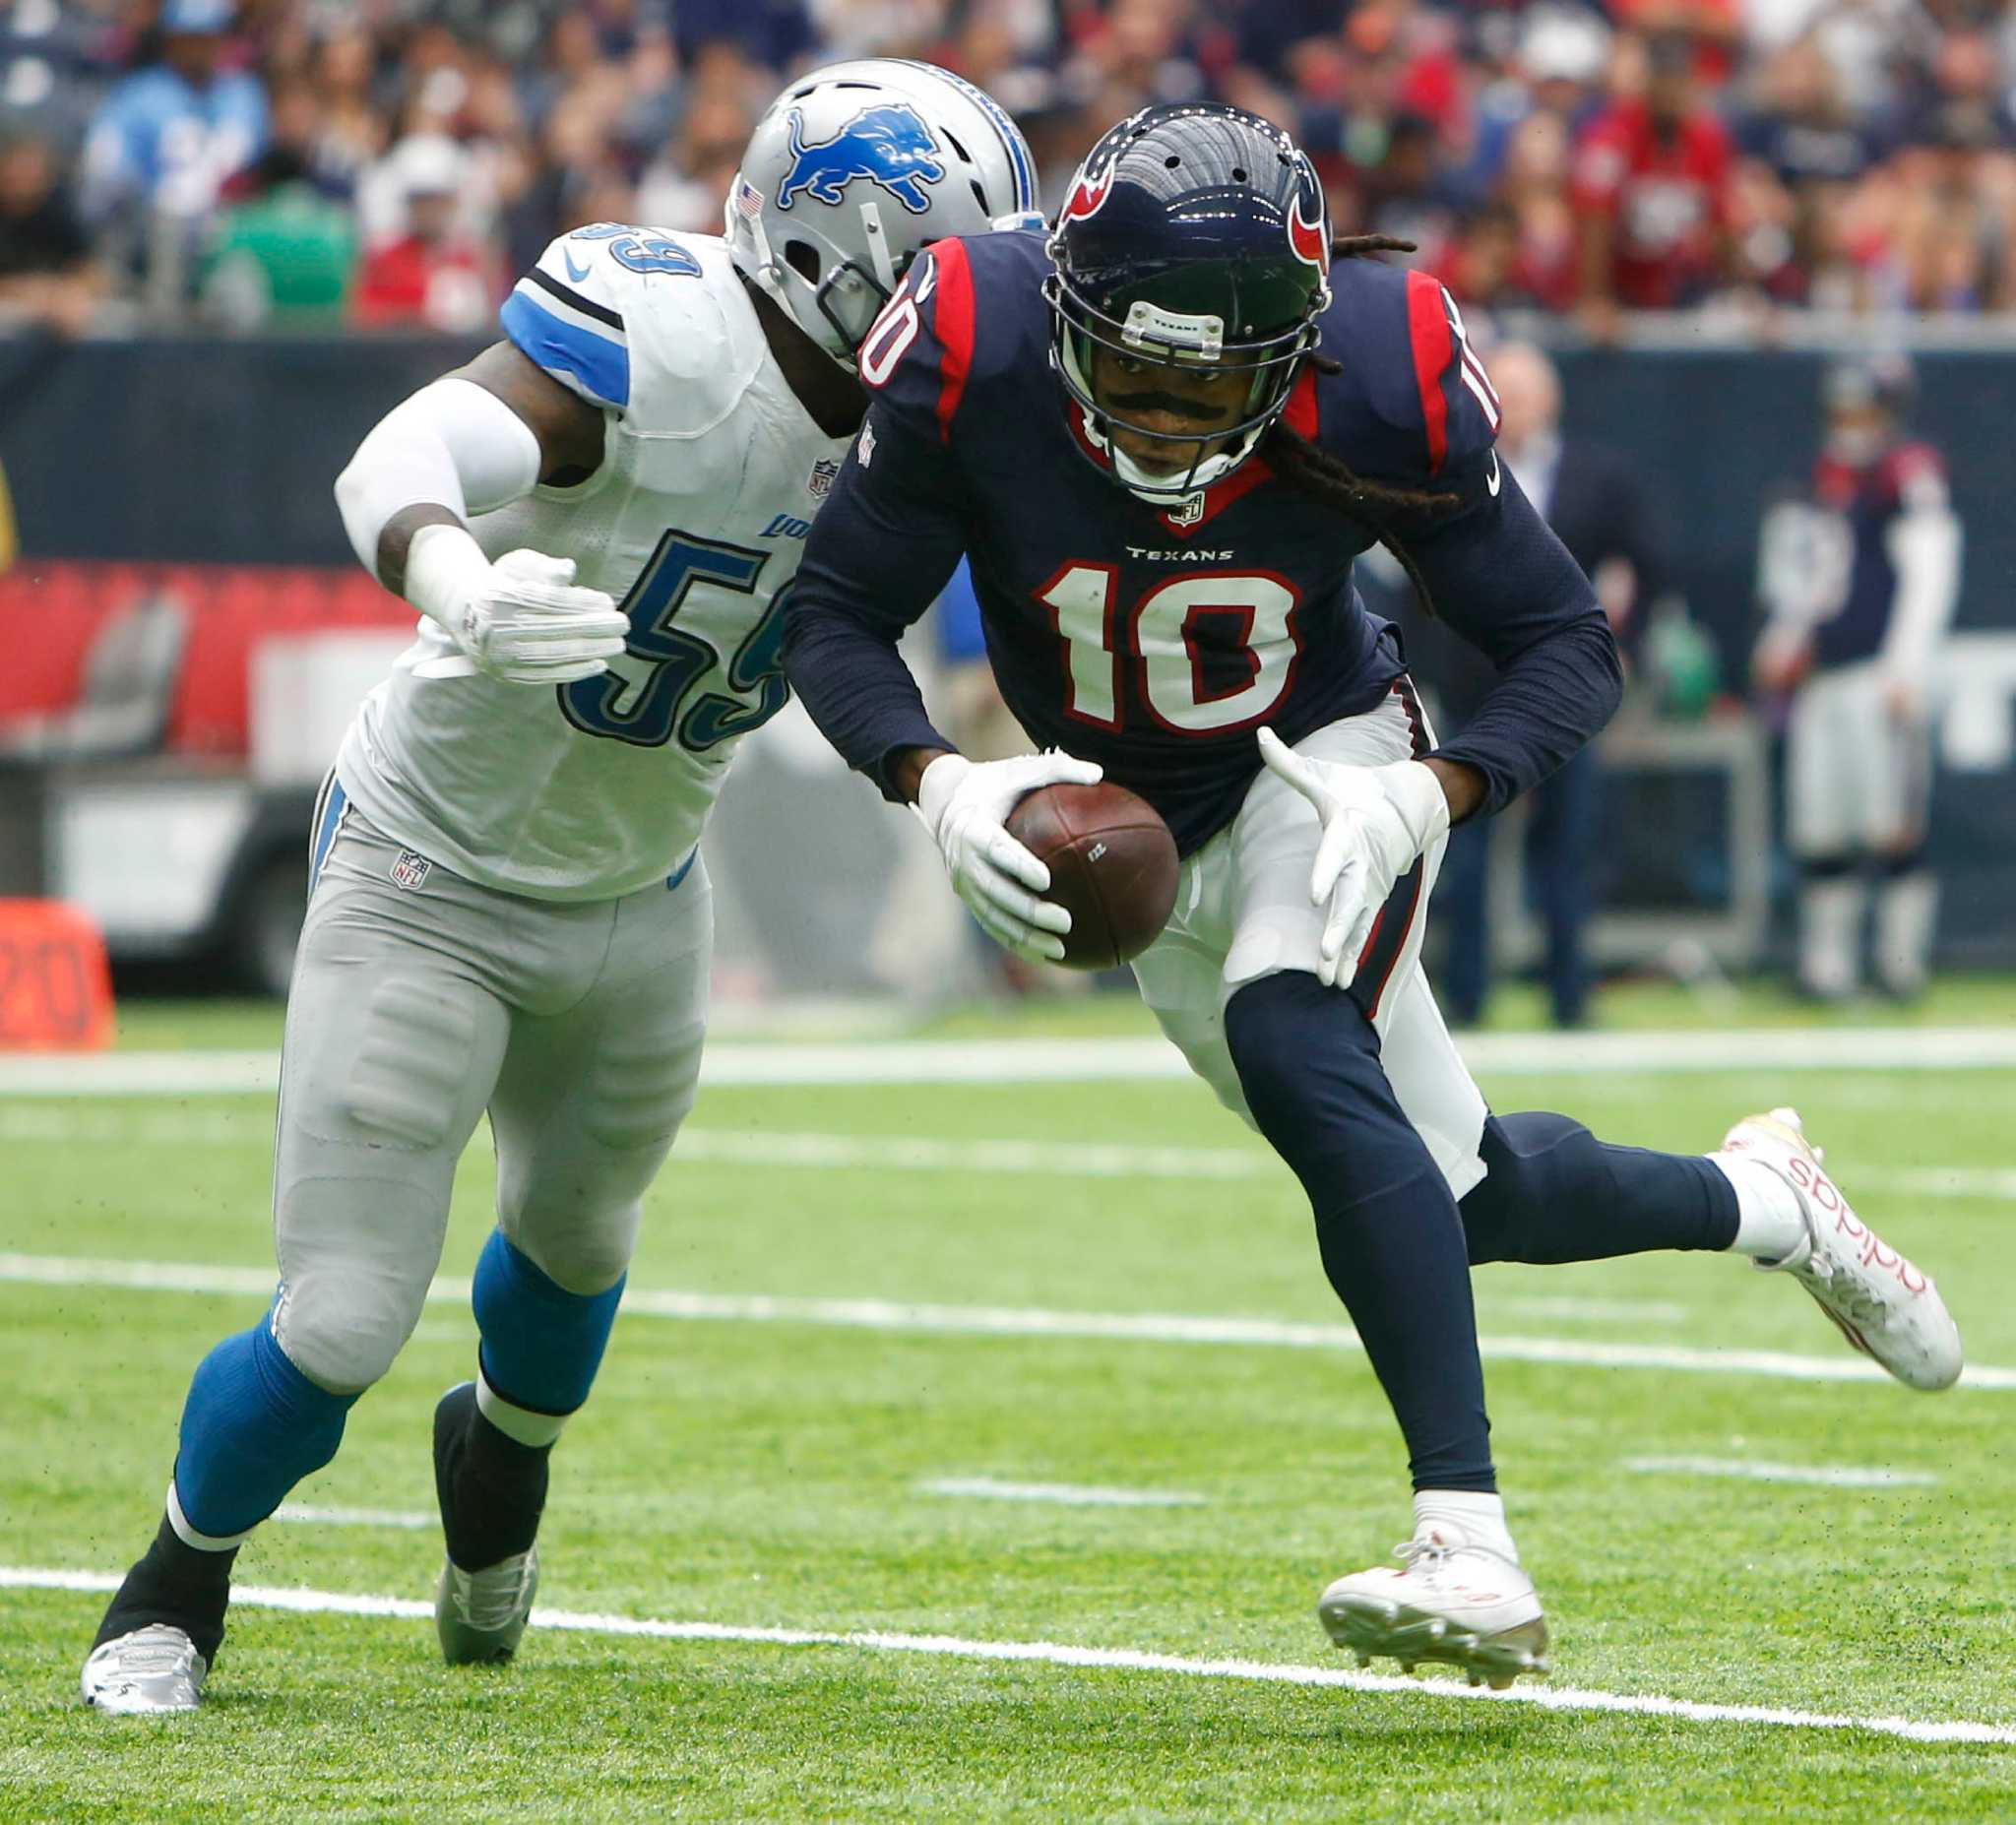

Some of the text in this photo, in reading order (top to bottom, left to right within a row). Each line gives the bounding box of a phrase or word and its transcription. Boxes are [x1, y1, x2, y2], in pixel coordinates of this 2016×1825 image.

[1125, 545, 1235, 561] TEXANS
[556, 528, 793, 752] 59
[1032, 560, 1304, 737] 10
[395, 862, 422, 885] NFL
[1786, 1155, 1929, 1295] adidas
